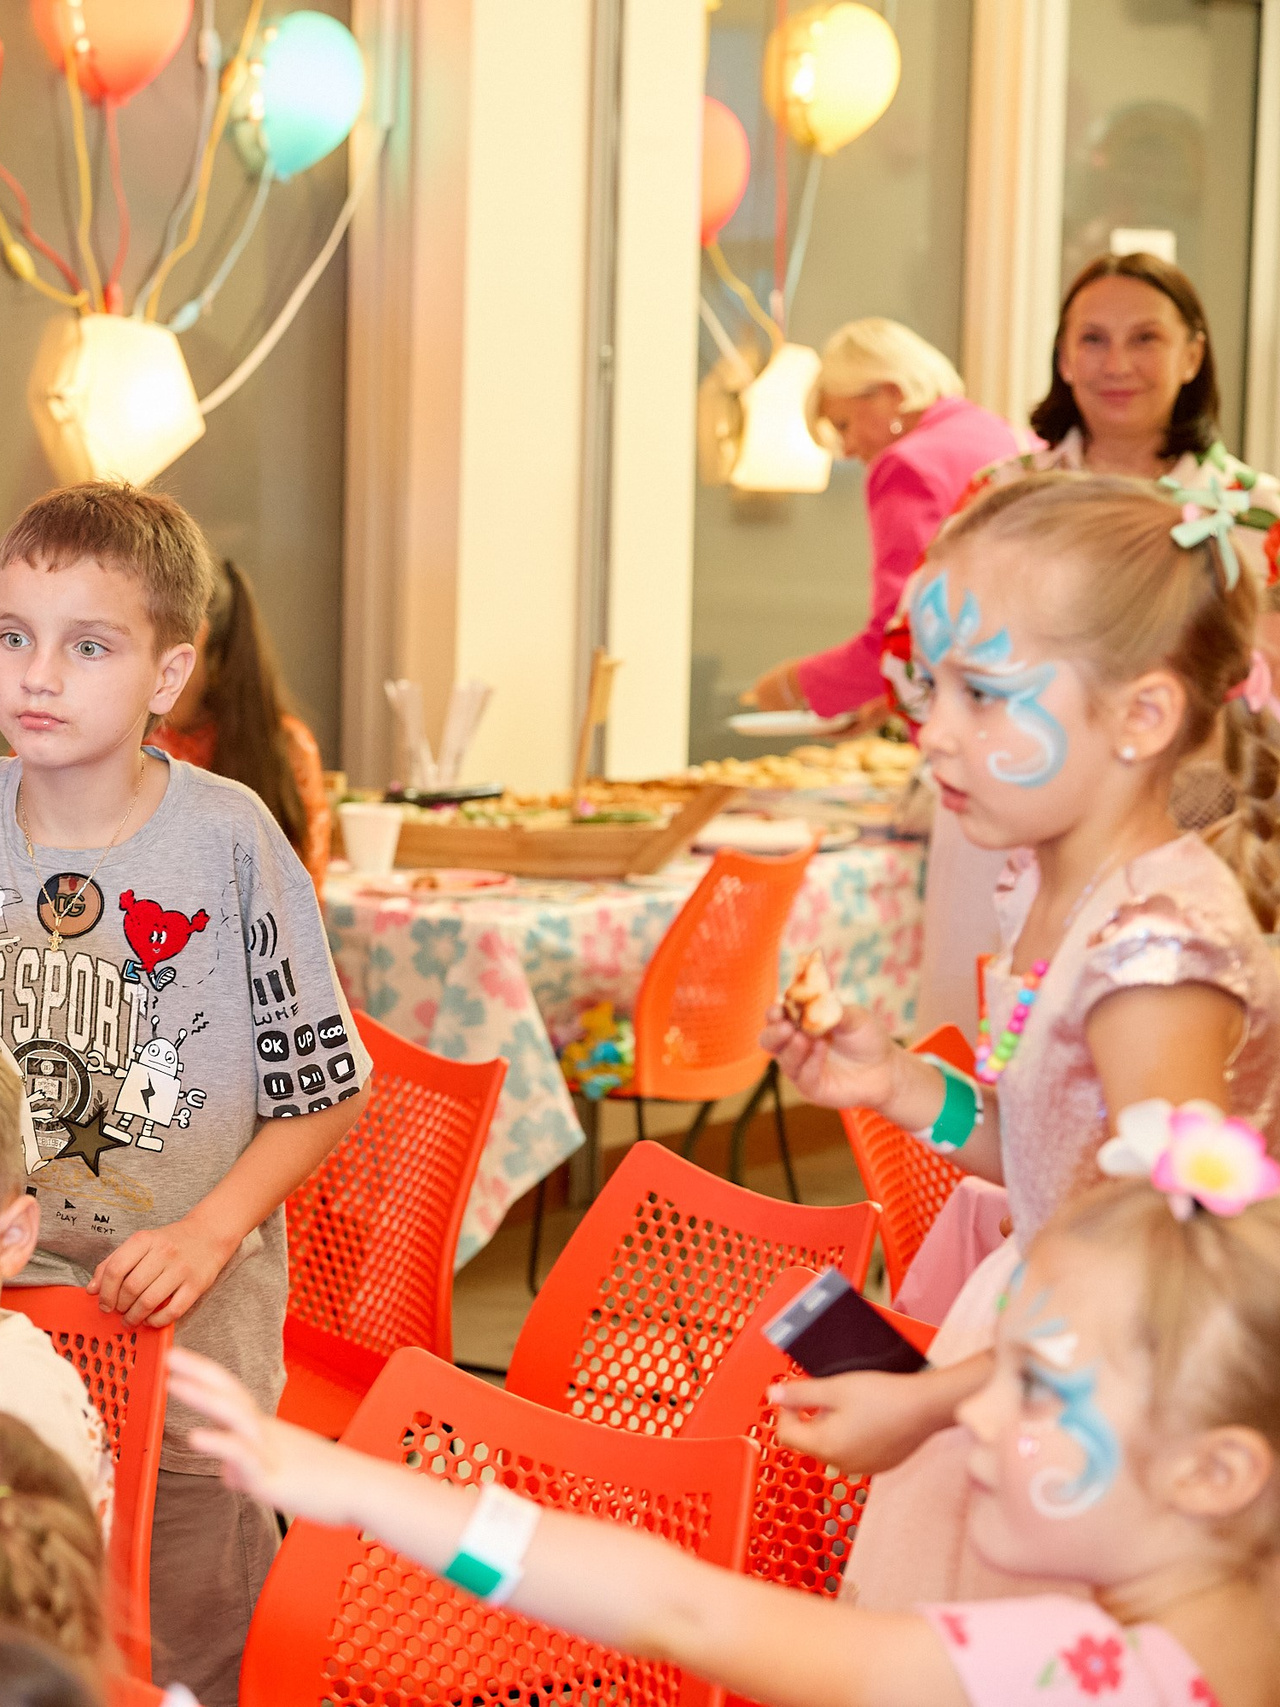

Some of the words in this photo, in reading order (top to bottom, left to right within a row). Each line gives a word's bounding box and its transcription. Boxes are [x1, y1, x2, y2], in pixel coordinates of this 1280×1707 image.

[54, 893, 86, 917] DG
[11, 947, 149, 1068] SPORT
[261, 1038, 284, 1054] OK
[298, 1031, 313, 1048] UP
[320, 1025, 347, 1039] COO
[56, 1211, 77, 1226] PLAY
[91, 1225, 116, 1235] NEXT
